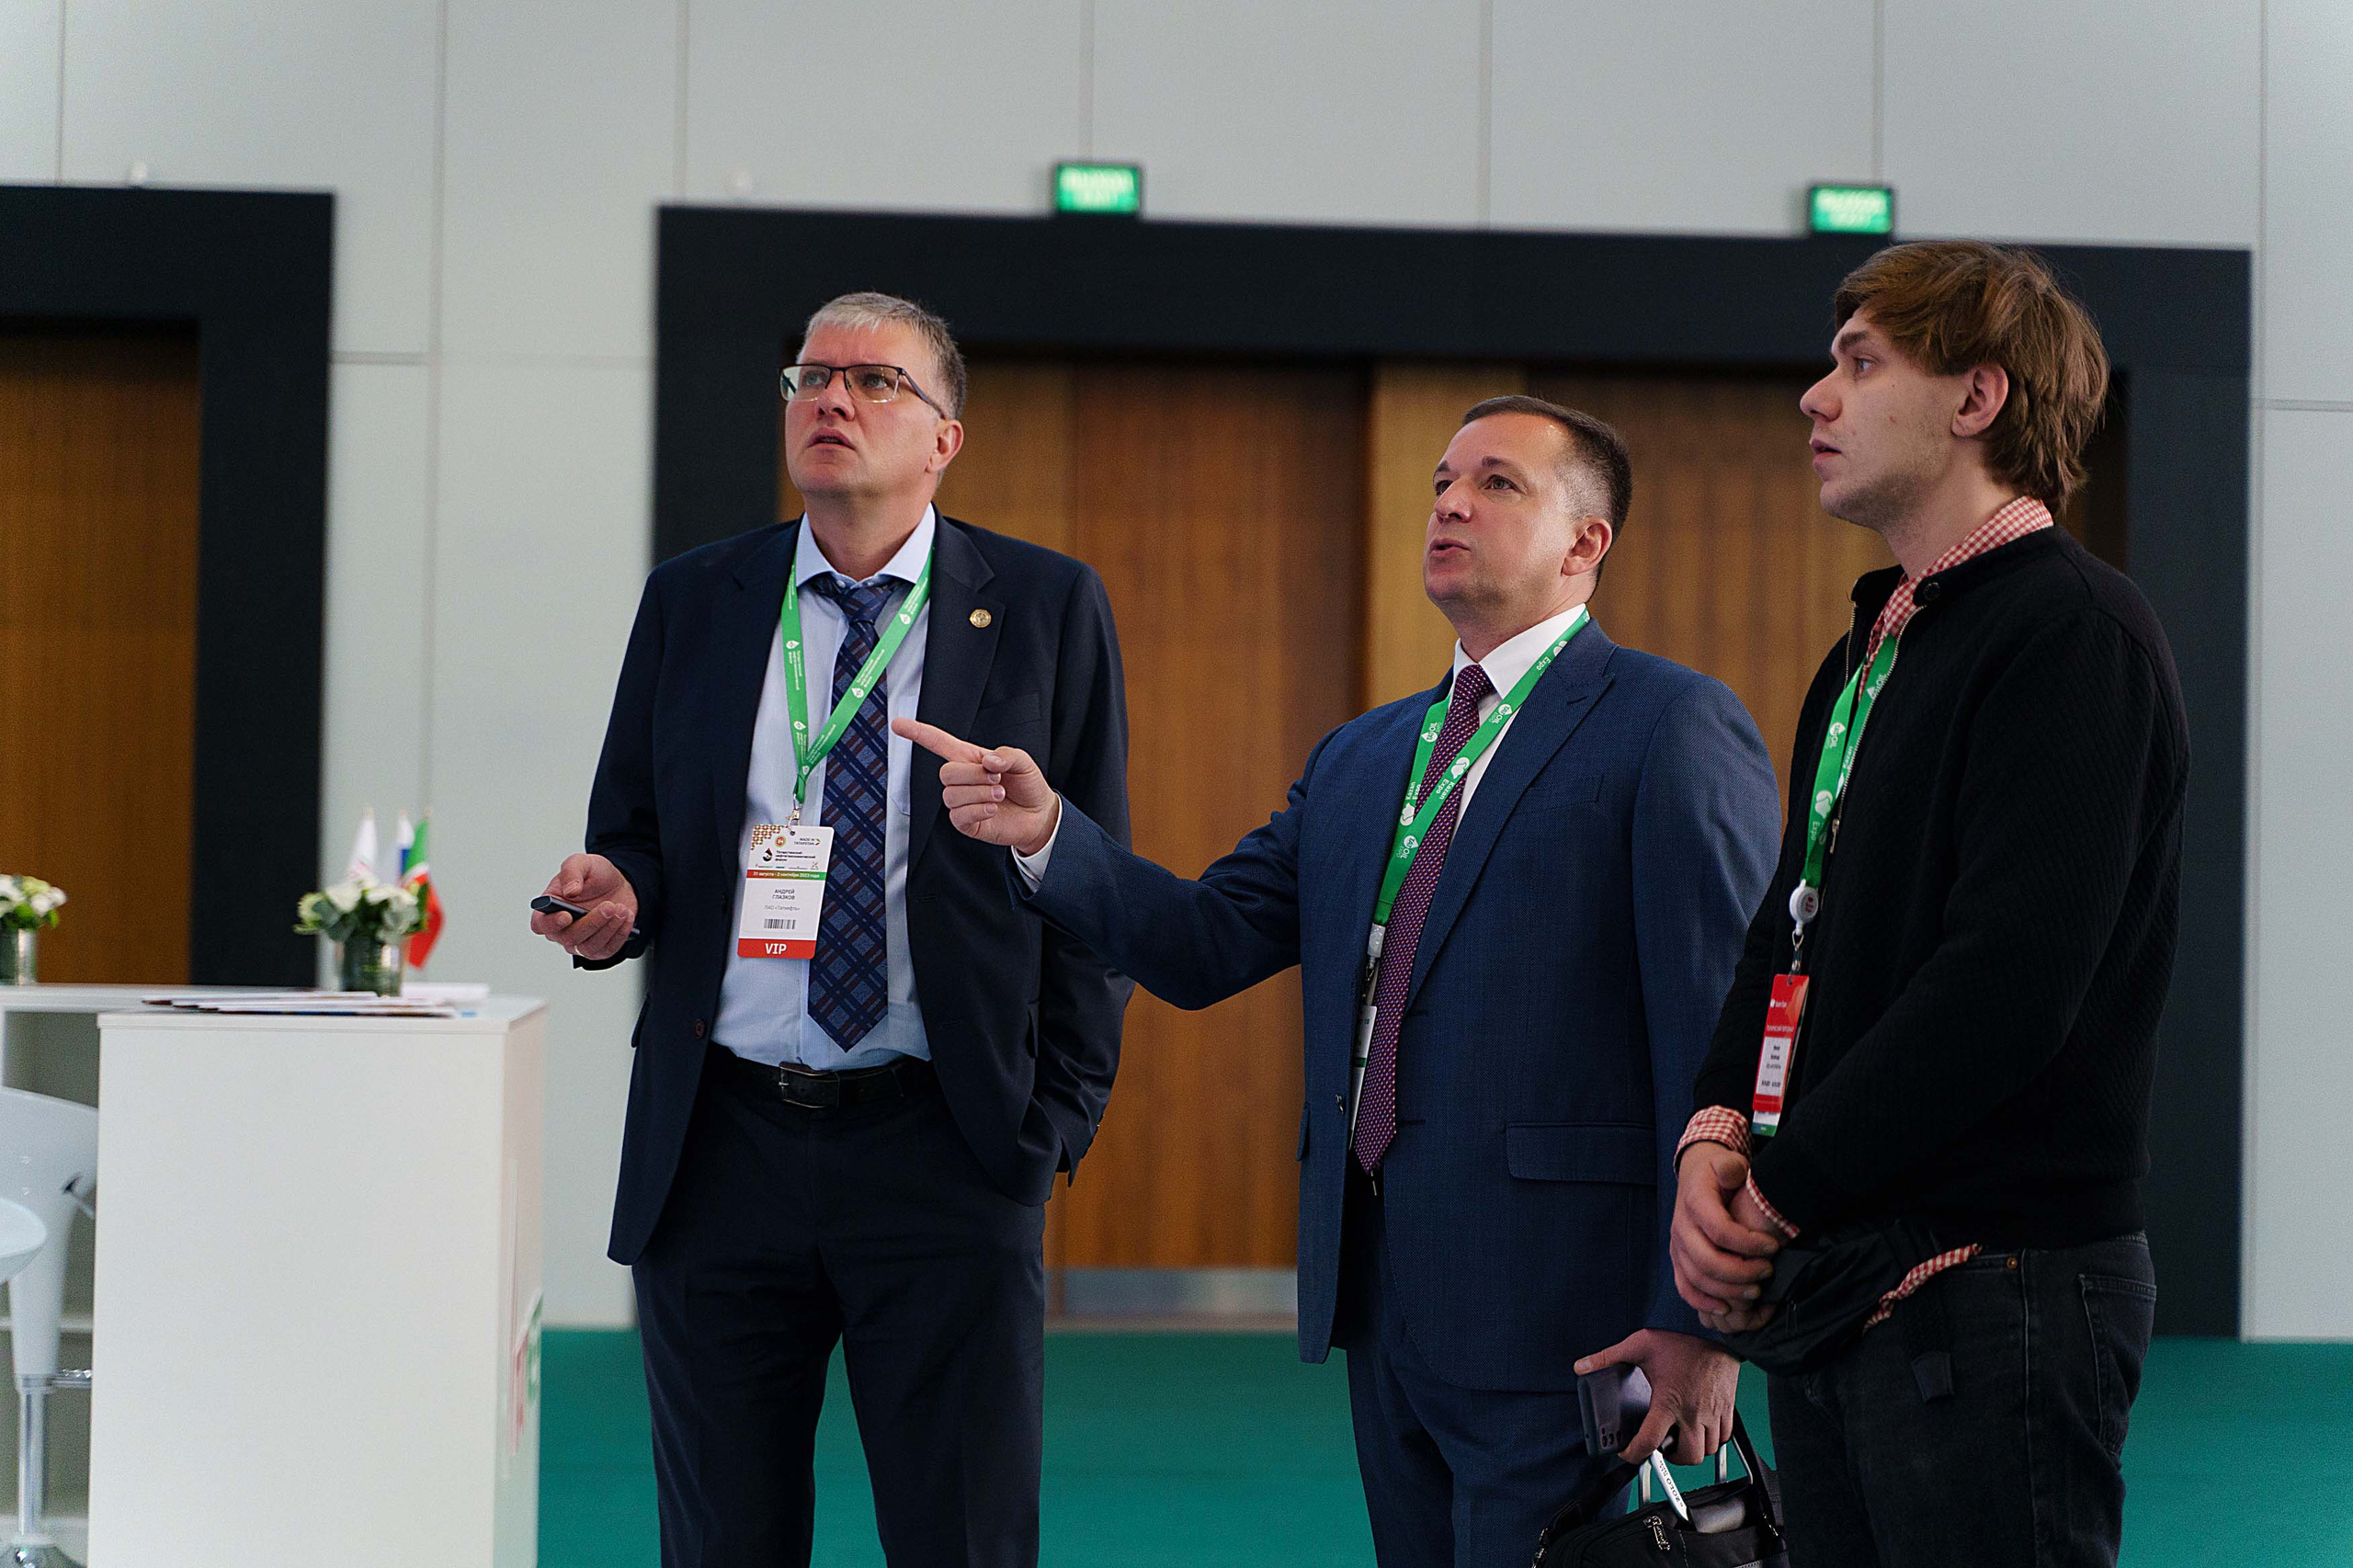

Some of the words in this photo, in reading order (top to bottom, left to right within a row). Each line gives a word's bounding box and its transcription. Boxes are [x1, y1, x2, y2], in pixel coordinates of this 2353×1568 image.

[1536, 656, 1552, 670] Expo
[1405, 782, 1415, 800] Kazan
[1436, 778, 1449, 794] Expo
[1439, 781, 1456, 800] Kazan
[765, 943, 787, 954] VIP
